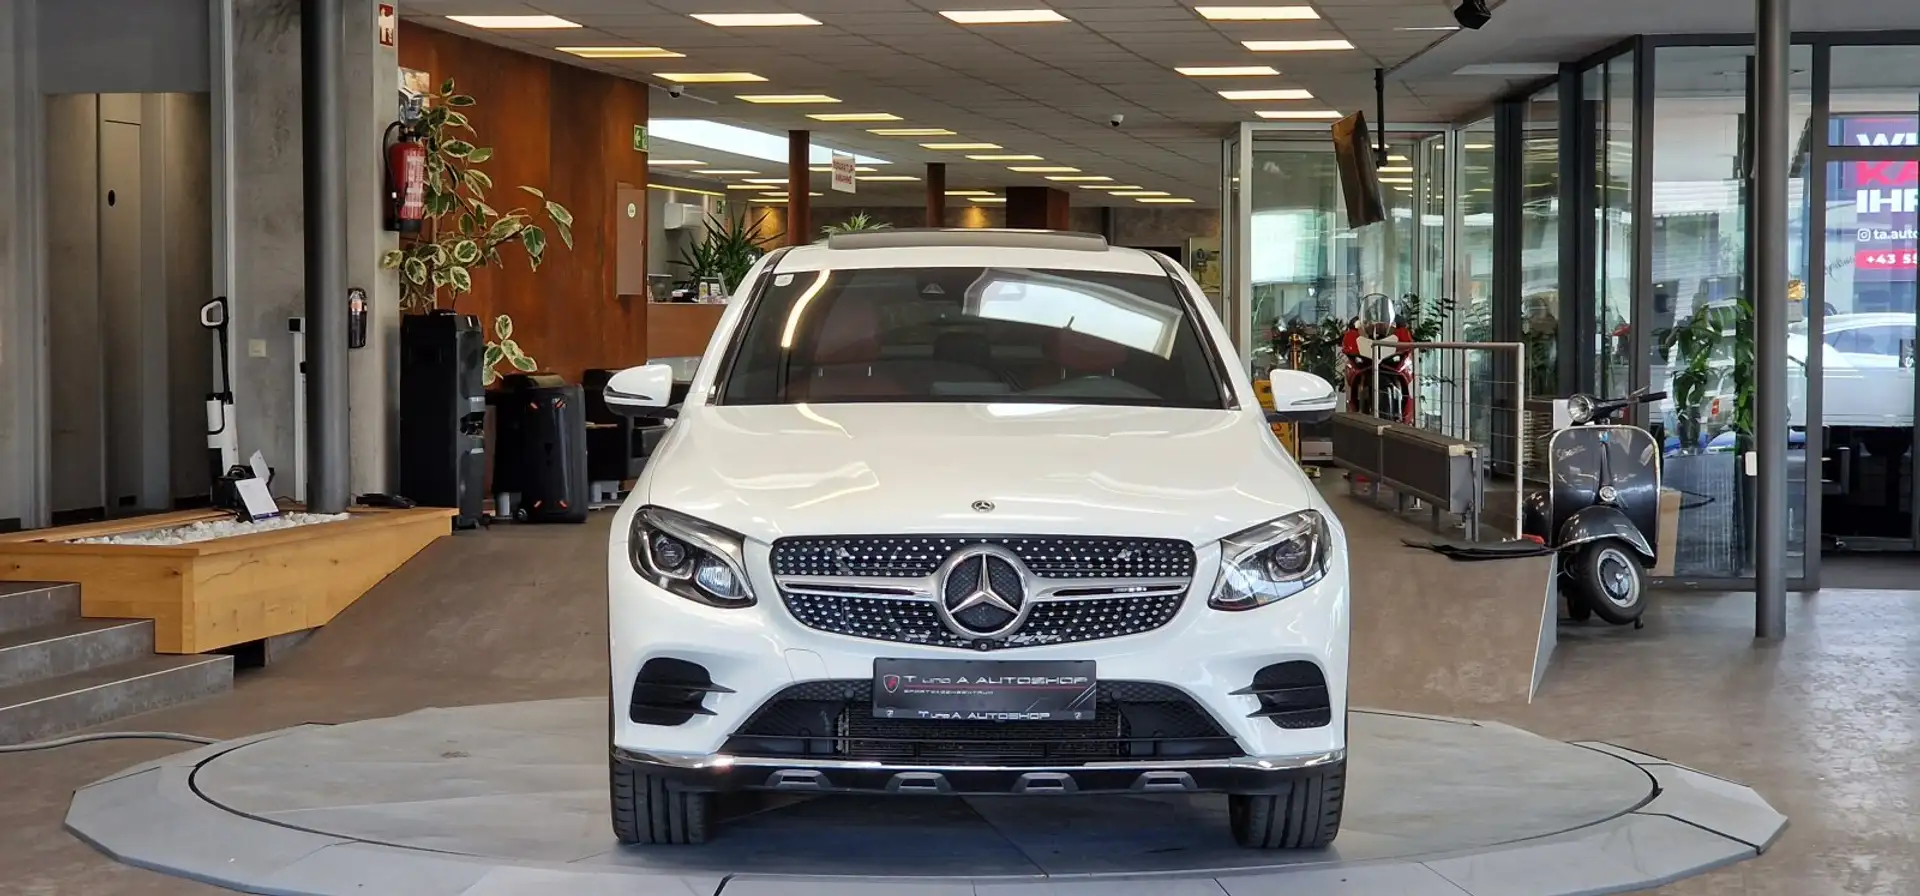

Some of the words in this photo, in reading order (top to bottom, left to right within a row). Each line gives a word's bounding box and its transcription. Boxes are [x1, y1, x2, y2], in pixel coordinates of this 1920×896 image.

[1866, 254, 1896, 265] +43
[903, 675, 917, 683] T
[956, 676, 970, 684] A
[975, 676, 1088, 685] AUTOSHOP
[918, 710, 929, 718] T
[951, 711, 961, 719] A
[967, 712, 1050, 720] AUTOSHOP
